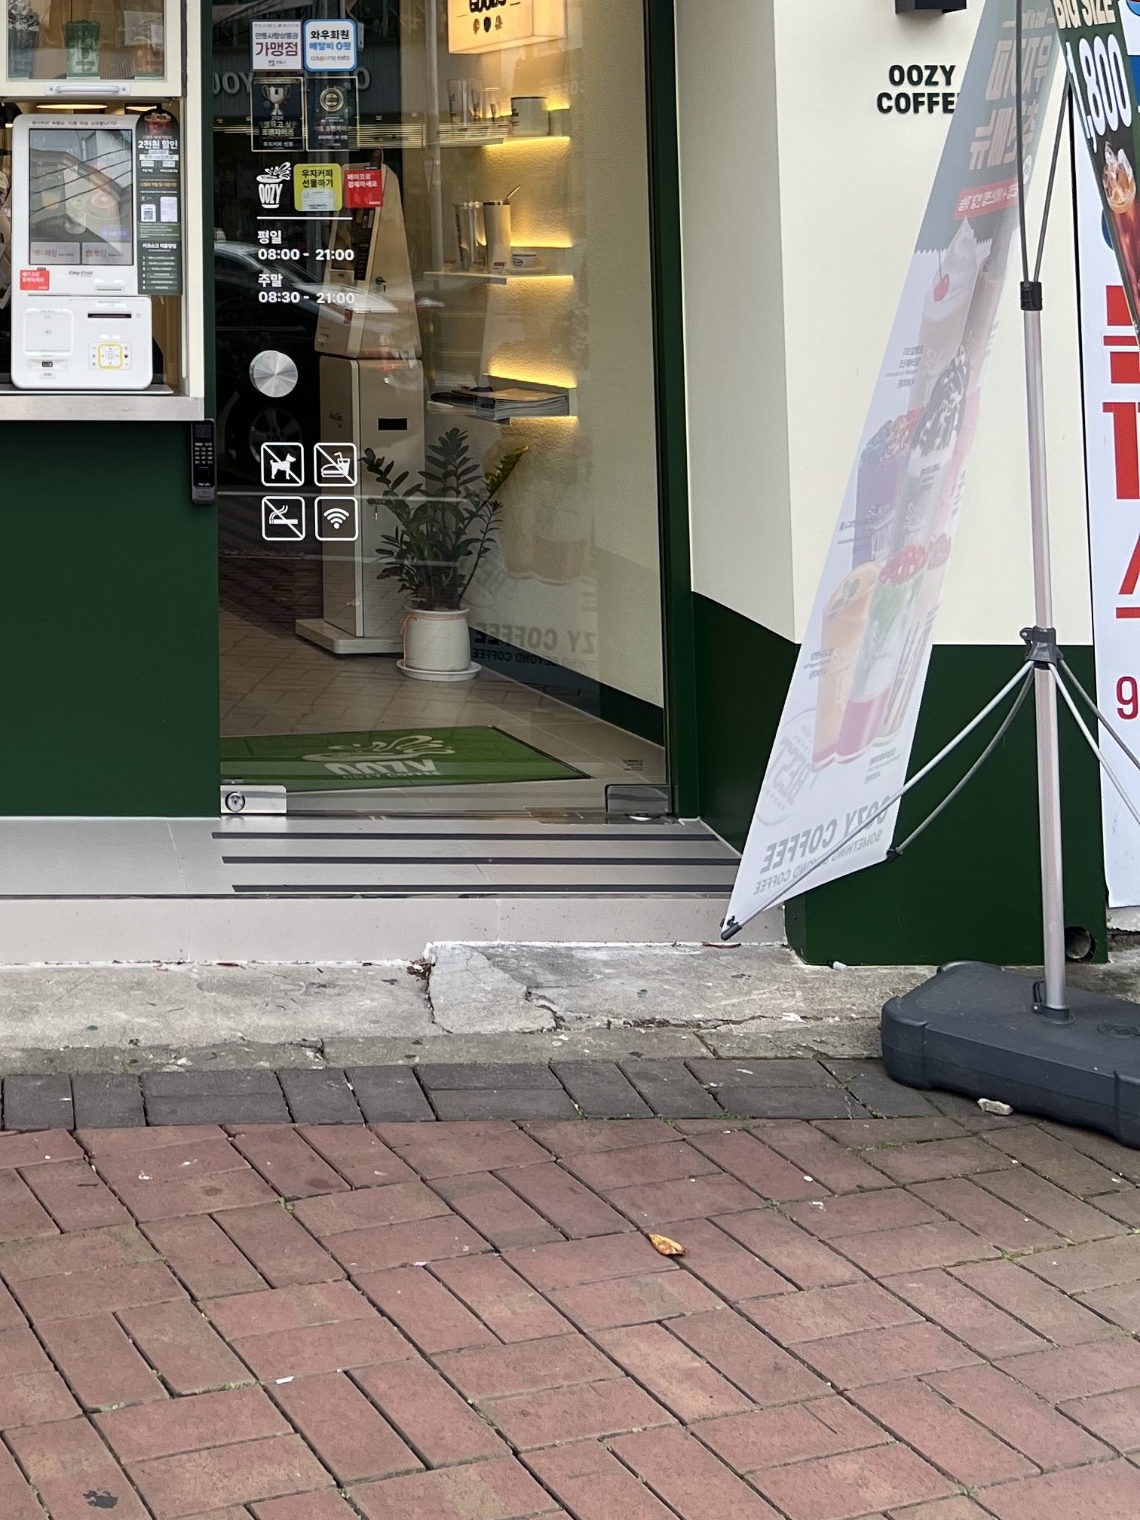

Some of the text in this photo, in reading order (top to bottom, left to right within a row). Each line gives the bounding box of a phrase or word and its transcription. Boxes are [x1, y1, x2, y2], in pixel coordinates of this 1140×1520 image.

[310, 29, 350, 40] 와우회원
[255, 42, 299, 57] 가맹점
[888, 65, 956, 86] OOZY
[876, 92, 959, 114] COFFE
[301, 169, 333, 178] 우지커피
[302, 179, 334, 189] 선물하기
[258, 184, 283, 204] OOZY
[257, 230, 282, 244] 평일
[258, 249, 300, 260] 08:00
[315, 249, 355, 260] 21:00
[258, 273, 283, 287] 주말
[258, 291, 300, 303] 08:30
[316, 292, 355, 304] 21:00
